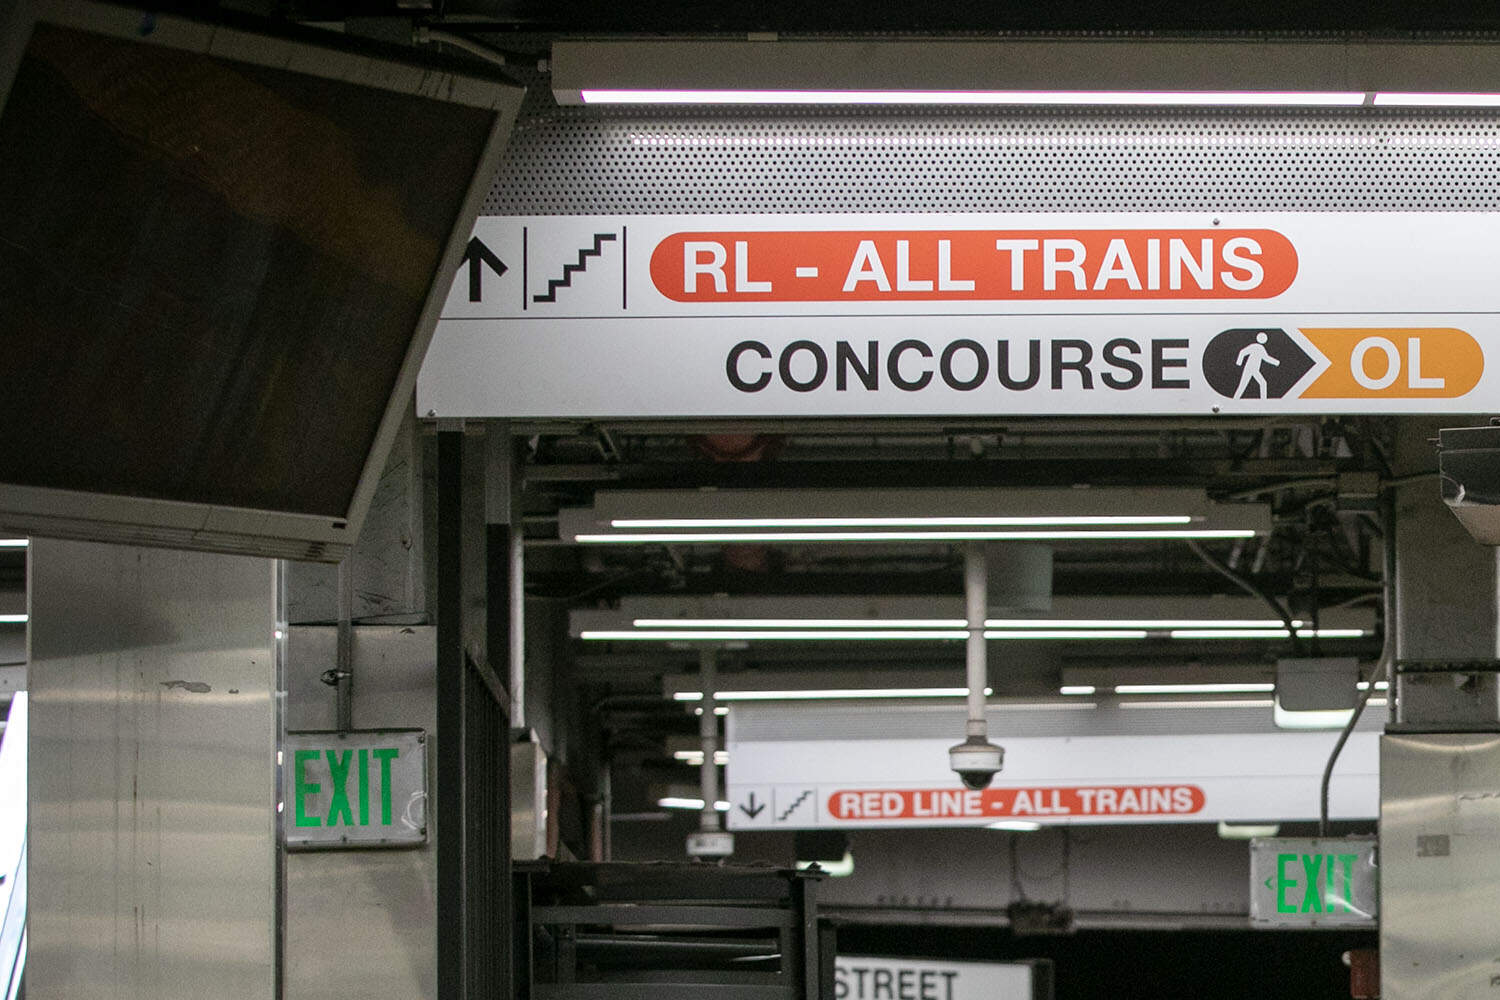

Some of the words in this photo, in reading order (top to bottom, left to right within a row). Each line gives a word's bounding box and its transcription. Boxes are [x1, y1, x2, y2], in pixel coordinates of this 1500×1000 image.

[683, 240, 773, 294] RL
[795, 266, 819, 278] -
[842, 239, 976, 292] ALL
[996, 236, 1265, 291] TRAINS
[725, 337, 1191, 394] CONCOURSE
[1350, 336, 1445, 390] OL
[295, 748, 399, 828] EXIT
[839, 793, 905, 819] RED
[913, 789, 983, 816] LINE
[1011, 789, 1070, 813] ALL
[1077, 787, 1194, 814] TRAINS
[1277, 853, 1359, 913] EXIT
